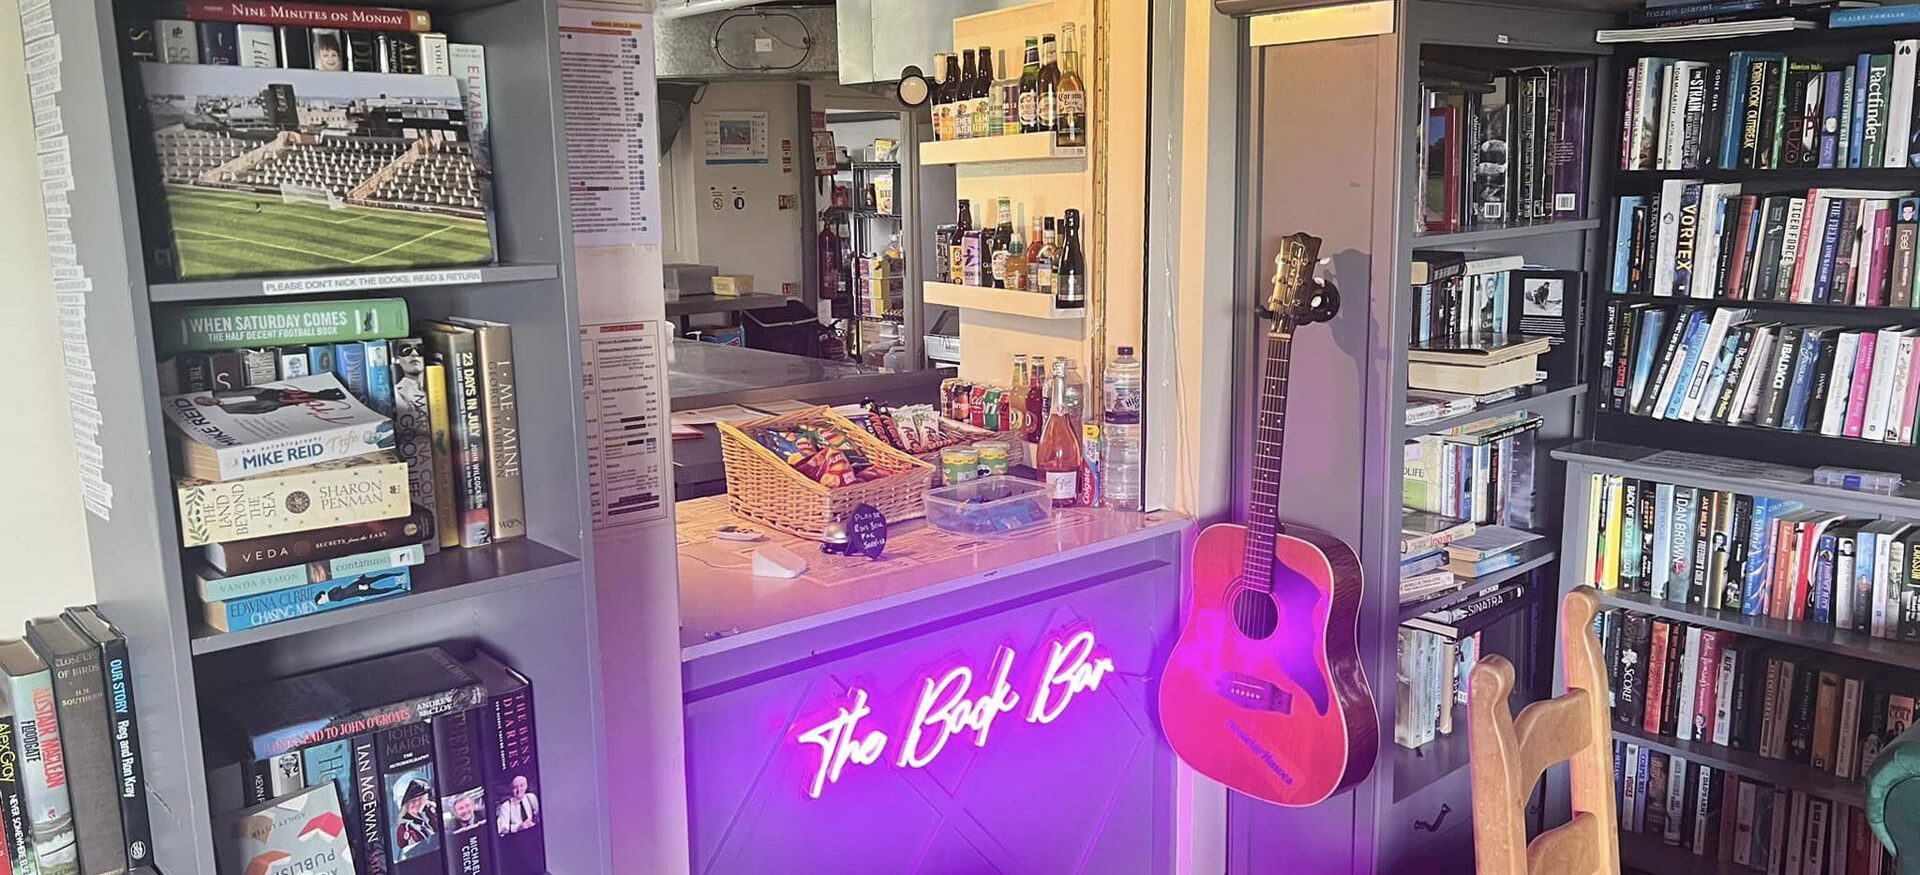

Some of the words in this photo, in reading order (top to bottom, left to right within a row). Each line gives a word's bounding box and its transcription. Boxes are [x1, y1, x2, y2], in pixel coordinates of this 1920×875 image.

[1647, 8, 1678, 18] frozen
[1681, 3, 1713, 14] planet
[1714, 68, 1722, 90] GONE
[1751, 62, 1764, 86] ROBIN
[1687, 79, 1704, 113] STRAIN
[1711, 93, 1719, 112] GIRL
[1748, 86, 1761, 107] COOK
[1864, 66, 1887, 143] Factfinder
[1743, 110, 1758, 149] OUTBREAK
[1789, 202, 1803, 231] TIGER
[1830, 200, 1843, 218] THE
[1676, 202, 1697, 274] VORTEX
[1826, 219, 1839, 244] FIELD
[1900, 229, 1912, 250] Feel
[1783, 232, 1798, 262] FORCE
[266, 281, 302, 293] PLEASE
[304, 280, 333, 291] DON'T
[334, 278, 356, 289] NICK
[357, 277, 377, 287] THE
[413, 274, 437, 283] READ
[447, 270, 481, 282] RETURN
[191, 316, 233, 333] WHEN
[236, 313, 300, 332] SATURDAY
[303, 311, 347, 327] COMES
[208, 333, 224, 342] THE
[225, 331, 243, 341] HALF
[245, 329, 276, 340] DECENT
[278, 328, 315, 338] FOOTBALL
[316, 327, 338, 336] BOOK
[462, 352, 474, 366] 23
[464, 367, 478, 394] DAYS
[468, 396, 478, 410] IN
[498, 383, 514, 411] ME
[469, 411, 481, 437] JULY
[242, 447, 285, 469] MIKE
[288, 443, 323, 461] REID
[493, 415, 506, 478] HARRISON
[501, 426, 519, 478] MINE
[319, 480, 383, 498] SHARON
[1083, 467, 1091, 504] Colgate
[1626, 485, 1636, 506] BACK
[202, 503, 216, 525] THE
[217, 495, 232, 528] LAND
[232, 484, 249, 535] BEYOND
[249, 496, 262, 519] THE
[263, 491, 277, 518] SEA
[320, 493, 383, 511] PENMAN
[1625, 507, 1635, 517] OF
[1676, 496, 1689, 522] DAN
[1755, 505, 1764, 515] In
[1623, 518, 1634, 547] BEYOND
[1699, 511, 1708, 538] MILLER
[315, 538, 346, 548] SECRETS
[1672, 521, 1687, 562] BROWN
[242, 549, 288, 562] VEDA
[219, 578, 260, 593] VANDA
[261, 573, 300, 588] SYMON
[230, 597, 277, 618] EDWINA
[279, 586, 316, 609] CURRIE
[1468, 594, 1504, 617] SINATRA
[250, 606, 298, 626] CHASING
[57, 670, 69, 679] OF
[72, 664, 99, 678] BIRDS
[110, 659, 123, 681] OUR
[1723, 655, 1733, 673] ALFIE
[1622, 665, 1635, 703] SCORE!
[112, 682, 128, 714] STORY
[516, 693, 527, 722] THE
[798, 688, 888, 798] The
[896, 645, 1020, 768] Back
[1025, 631, 1115, 724] Bar
[117, 720, 129, 739] Reg
[326, 727, 338, 740] TO
[340, 719, 366, 737] JOHN
[387, 724, 426, 742] JOHN
[502, 697, 520, 769] DIARIES
[21, 720, 41, 764] FLOODGATE
[118, 738, 130, 756] and
[385, 734, 432, 757] MAJOR
[519, 726, 530, 765] BENN
[121, 757, 132, 776] Ron
[357, 743, 371, 772] IAN
[123, 777, 136, 798] Kray
[254, 774, 264, 798] KEVIN
[1625, 775, 1634, 799] VOICES
[9, 794, 19, 816] NEVER
[12, 817, 26, 858] SOMEWHERE
[460, 845, 471, 873] CRICK
[468, 836, 482, 874] MICHAEL
